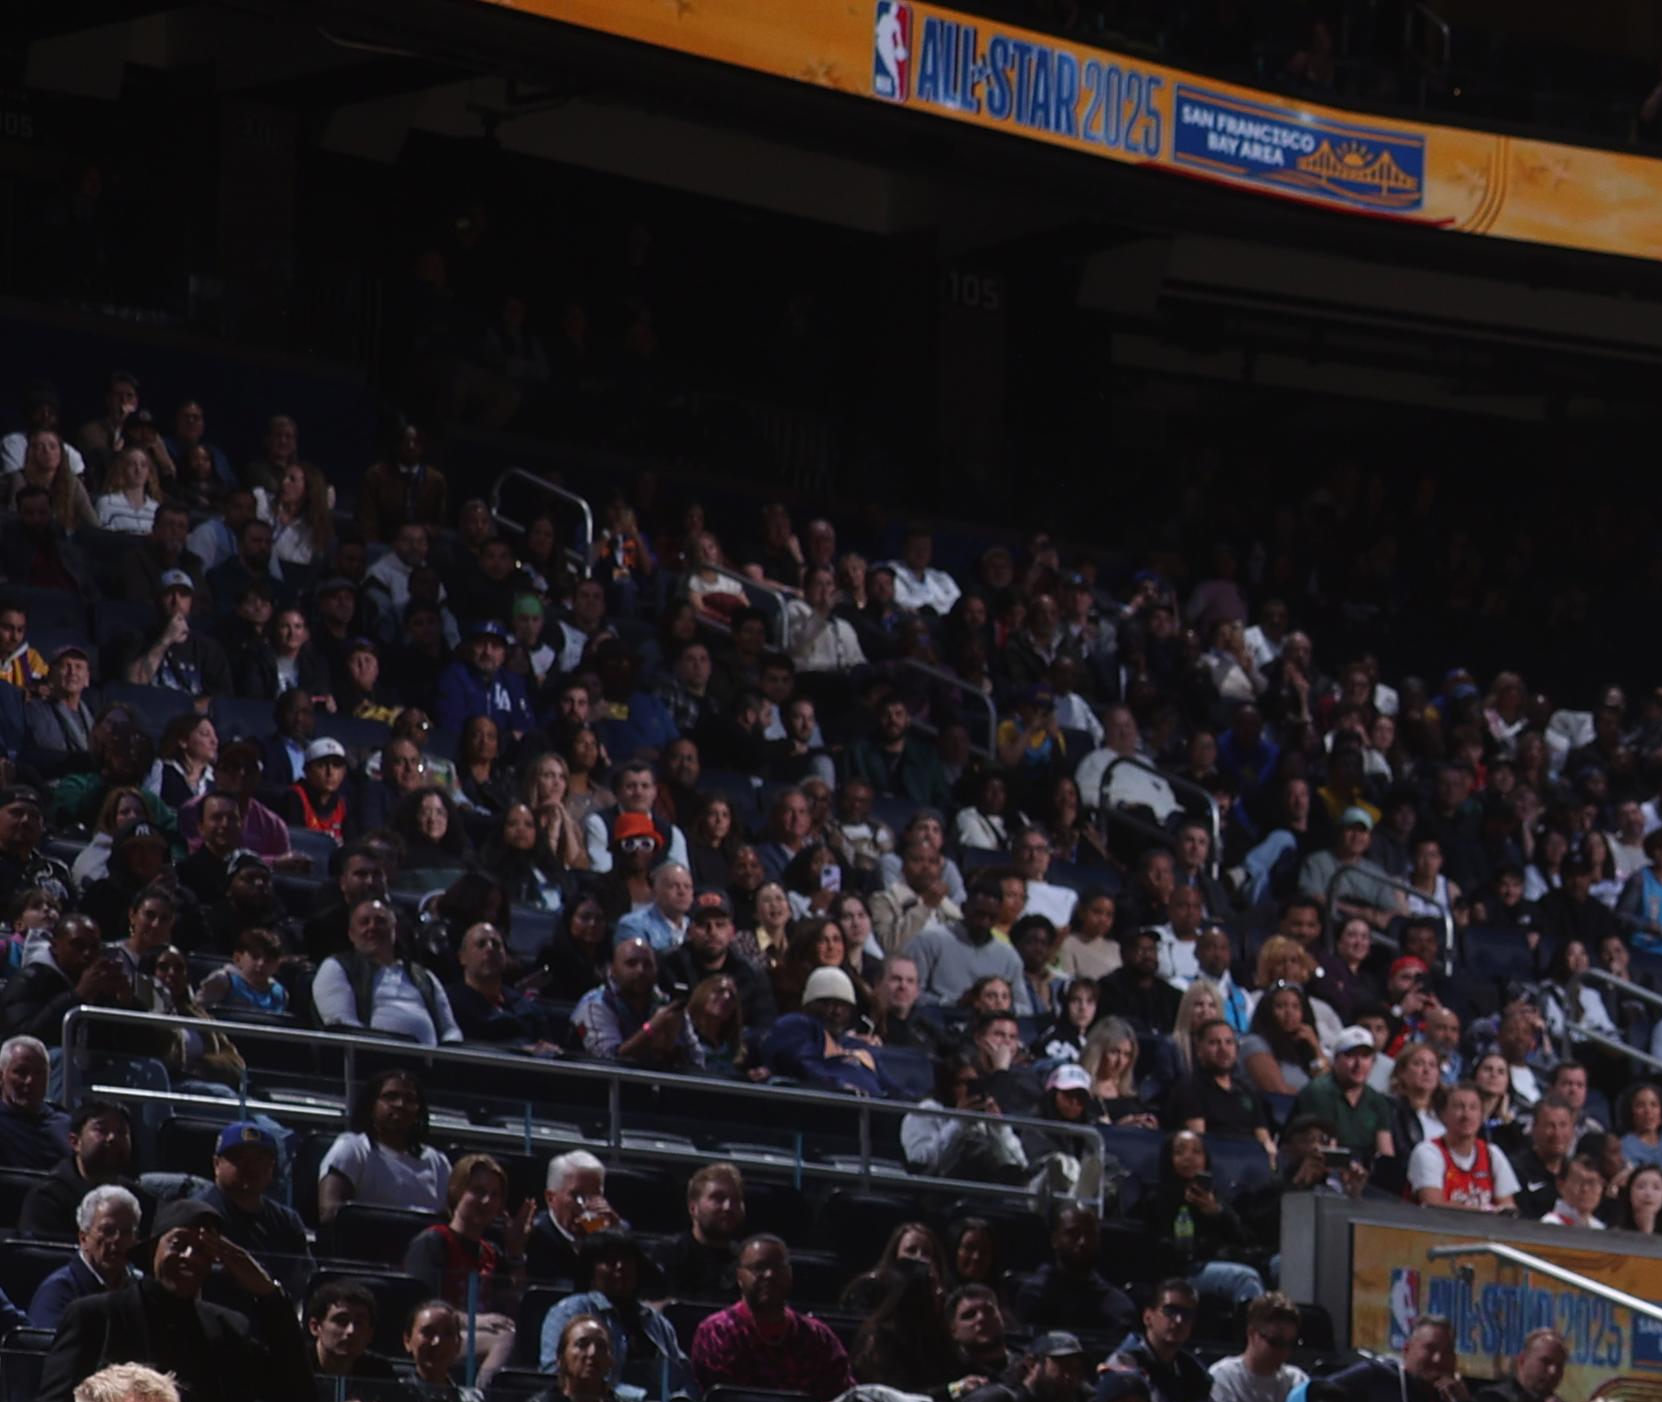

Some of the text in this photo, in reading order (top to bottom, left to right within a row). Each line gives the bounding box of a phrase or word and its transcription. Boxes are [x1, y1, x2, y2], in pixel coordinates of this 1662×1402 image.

[1081, 61, 1164, 161] 2025
[1182, 104, 1316, 154] SAN FRANCISCO
[1207, 130, 1284, 166] BAY AREA
